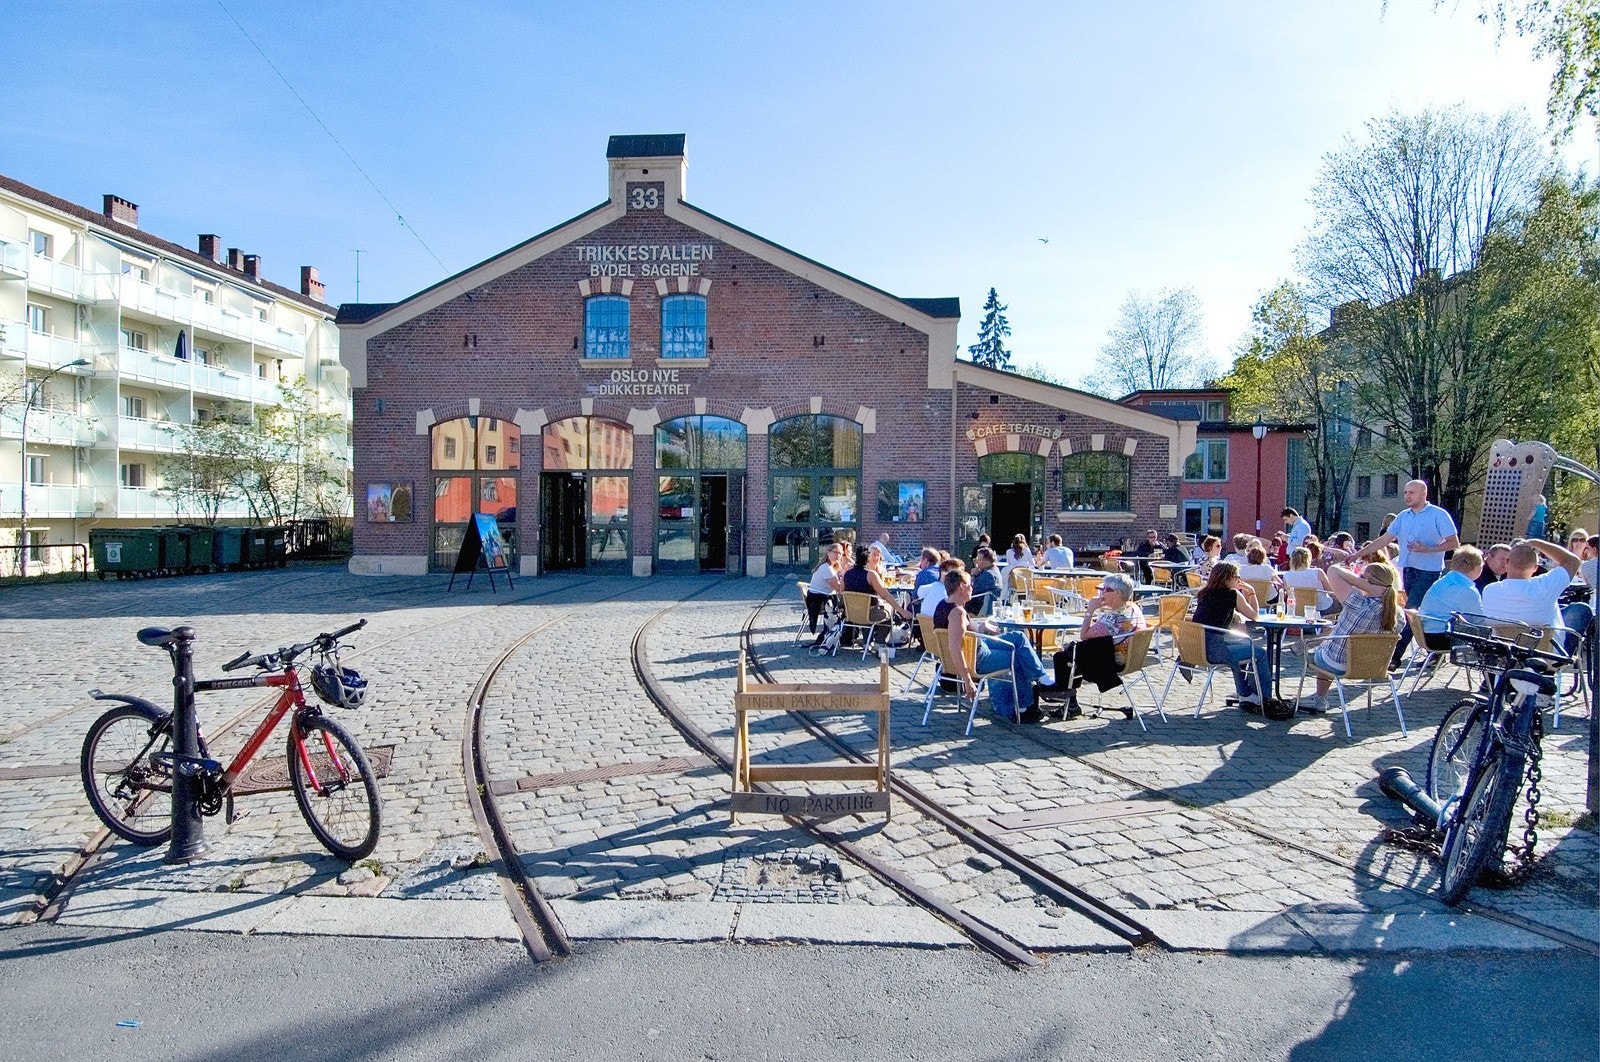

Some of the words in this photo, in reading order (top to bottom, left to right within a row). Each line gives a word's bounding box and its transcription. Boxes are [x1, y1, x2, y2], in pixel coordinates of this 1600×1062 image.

[632, 188, 658, 209] 33
[575, 245, 713, 262] TRIKKESTALLEN
[590, 264, 635, 277] BYDEL
[641, 263, 699, 277] SAGENE
[611, 370, 649, 383] OSLO
[653, 370, 679, 383] NYE
[599, 384, 691, 395] DUKKETEATRET
[976, 422, 1007, 437] CAFÉ
[1008, 423, 1051, 437] TEATER
[748, 696, 785, 709] INGEN
[791, 695, 860, 709] PARKERING
[766, 796, 790, 813] NO
[802, 796, 873, 814] PARKING
